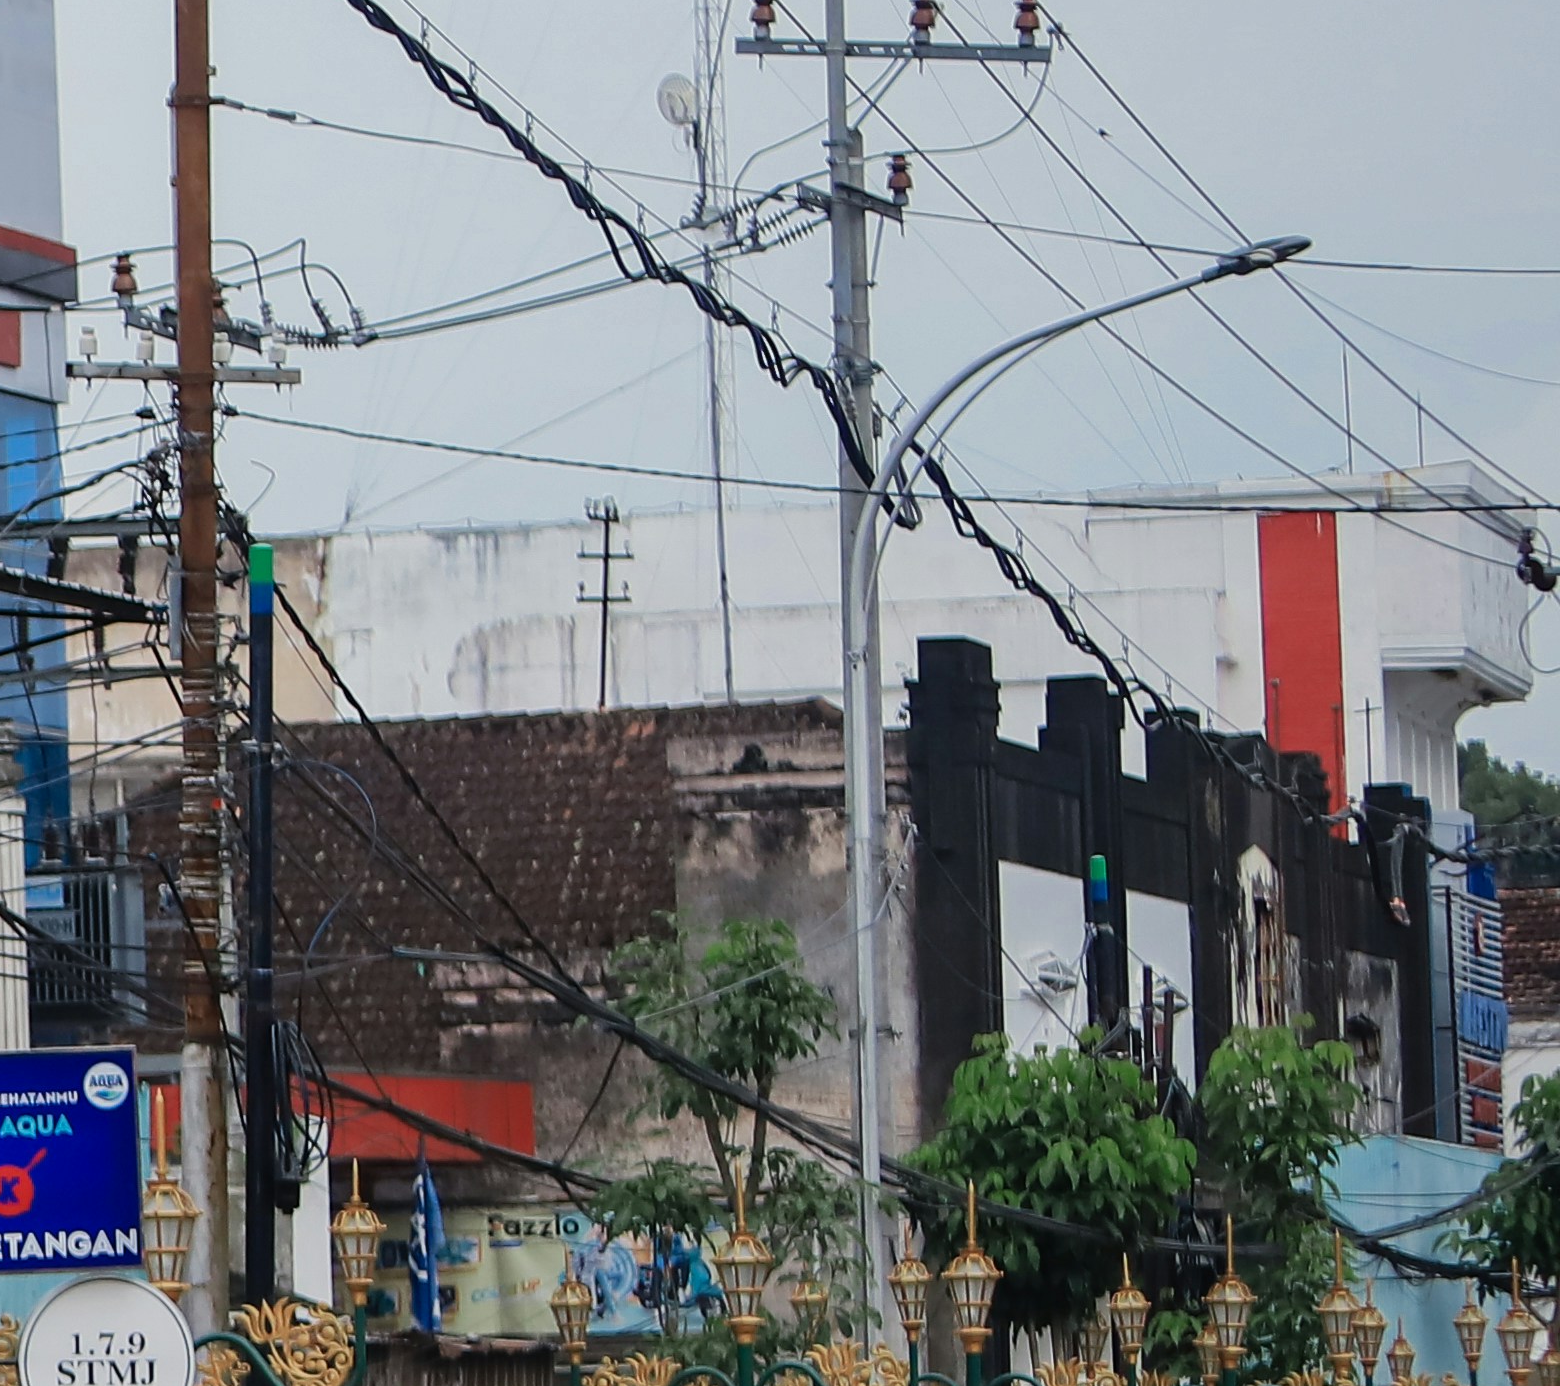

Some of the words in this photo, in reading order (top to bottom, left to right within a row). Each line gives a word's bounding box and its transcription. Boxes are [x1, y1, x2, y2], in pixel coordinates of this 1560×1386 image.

[89, 1073, 124, 1088] AQUA
[0, 1114, 73, 1139] AQUA
[72, 1331, 146, 1355] 1.7.9
[57, 1359, 157, 1386] STMJ
